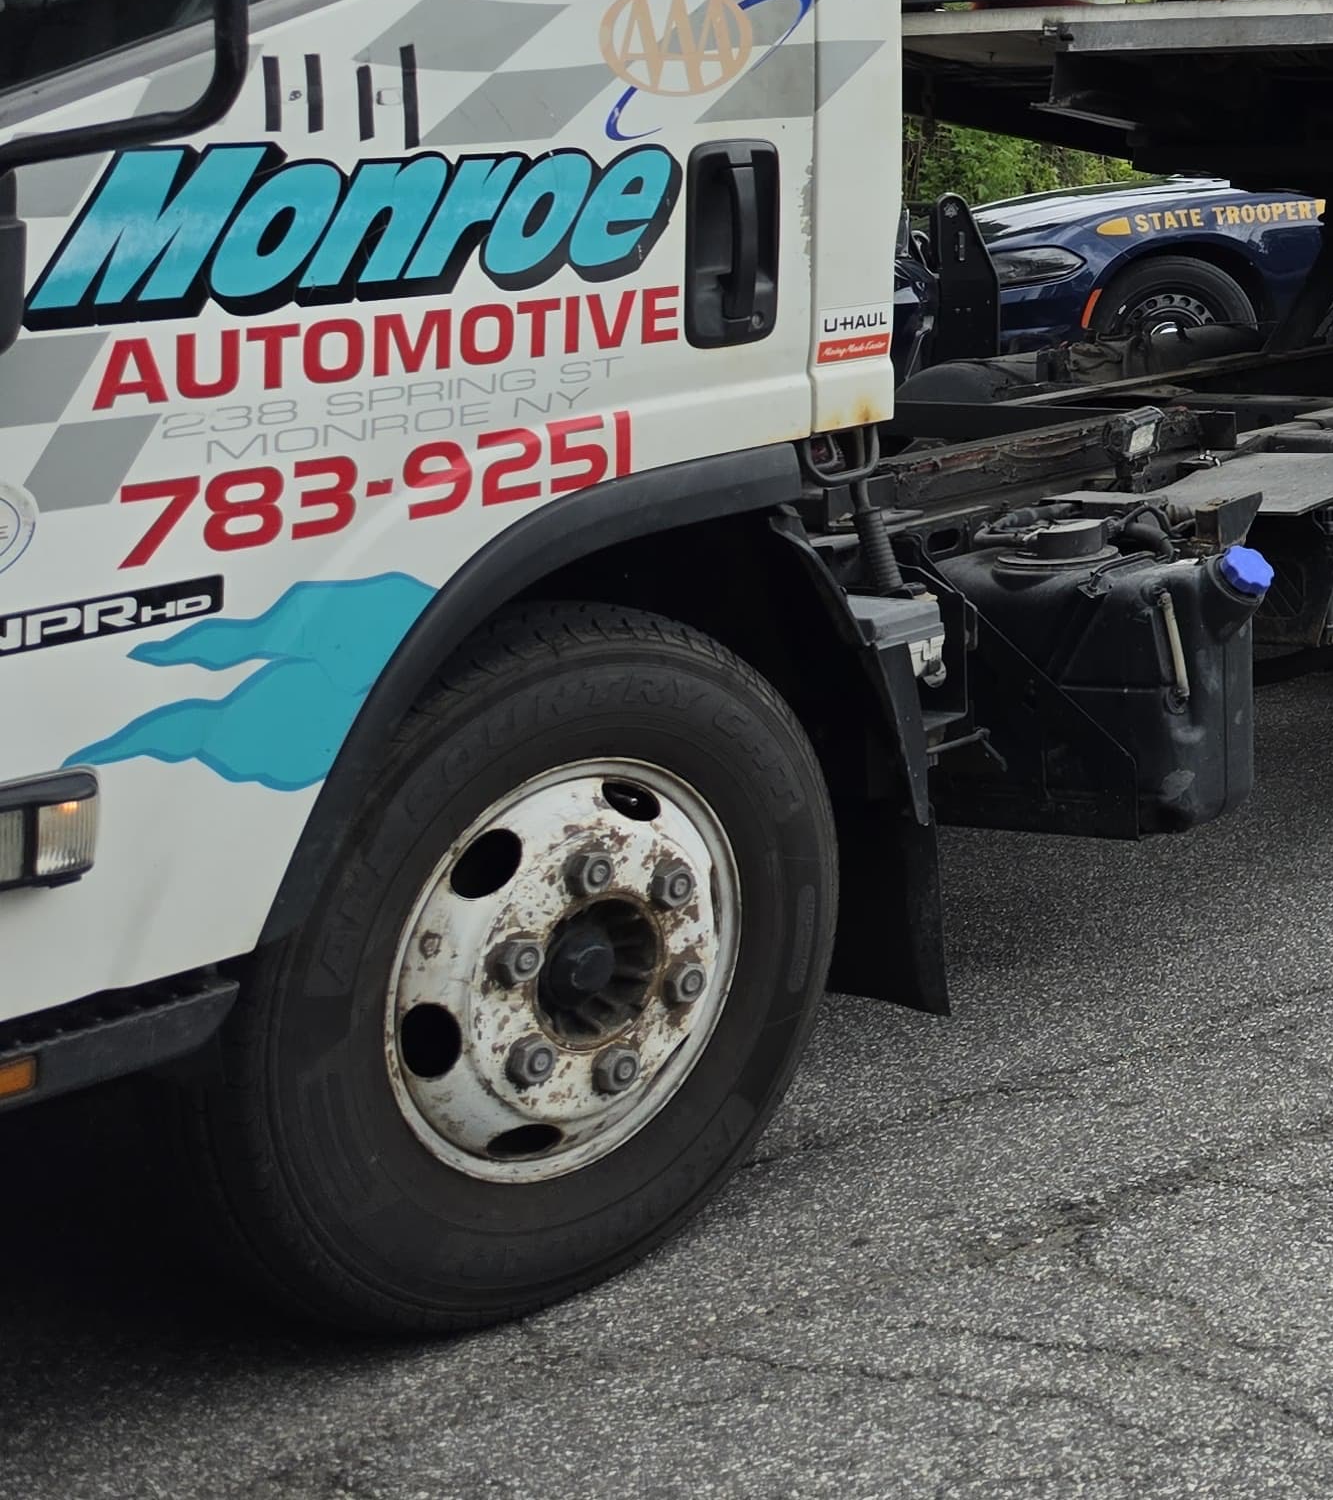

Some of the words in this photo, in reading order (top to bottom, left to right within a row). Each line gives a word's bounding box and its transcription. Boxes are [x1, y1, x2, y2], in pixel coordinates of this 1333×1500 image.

[26, 143, 681, 326] Monroe
[1133, 208, 1205, 234] STATE
[1211, 200, 1314, 226] TROOPER
[92, 284, 680, 411] AUTOMOTIVE
[824, 311, 888, 333] U-HAUL
[161, 400, 297, 440] 238
[326, 368, 538, 417] SPRING
[558, 355, 624, 385] ST
[206, 400, 491, 463] MONROE
[513, 387, 591, 418] NY
[117, 410, 632, 570] 783-9251
[141, 595, 212, 623] HD
